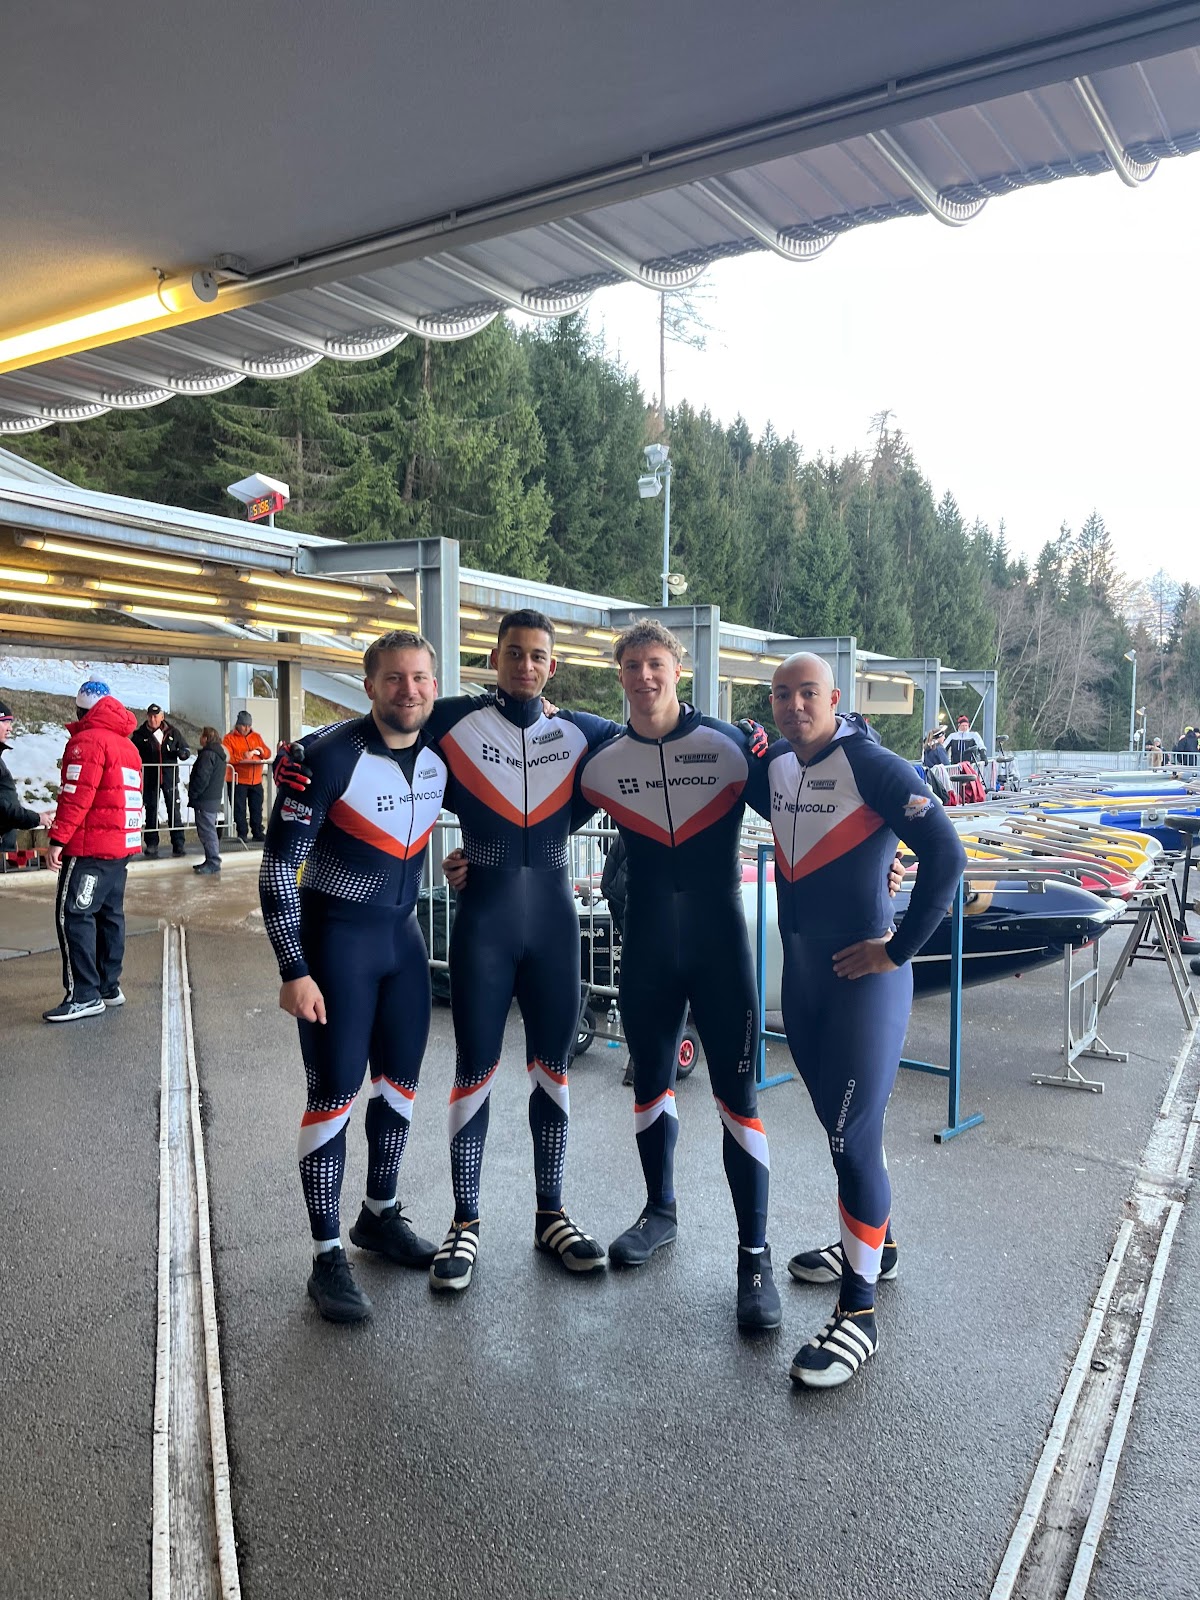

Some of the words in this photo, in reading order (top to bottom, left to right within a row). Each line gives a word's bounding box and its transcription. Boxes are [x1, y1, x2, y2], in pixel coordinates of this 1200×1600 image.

[506, 751, 570, 769] NEWCOLD
[646, 776, 717, 789] NEWCOLD
[284, 796, 313, 816] BSBN
[399, 789, 443, 805] NEWCOLD
[784, 803, 836, 814] NEWCOLD
[743, 1009, 753, 1057] NEWCOLD
[836, 1079, 856, 1132] NEWCOLD
